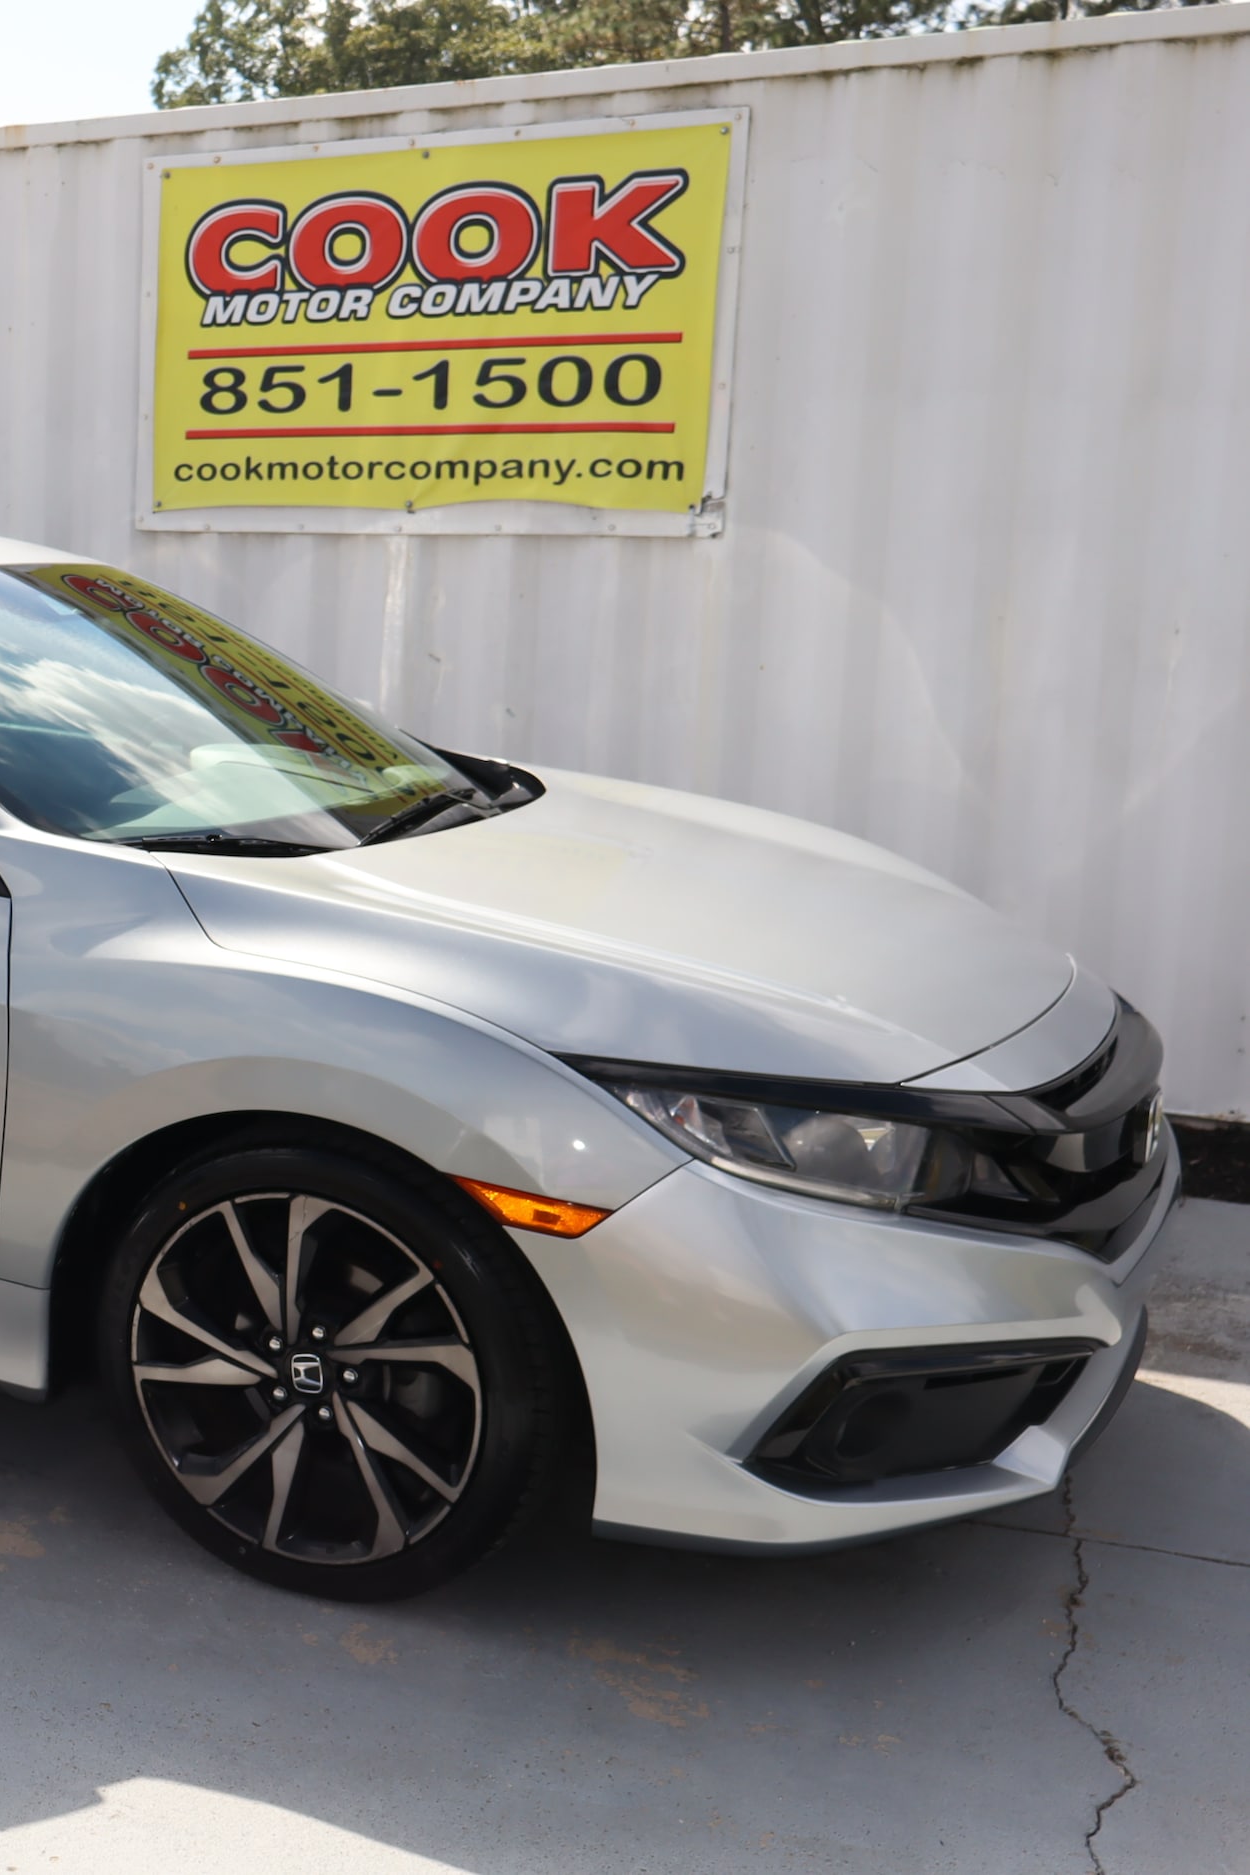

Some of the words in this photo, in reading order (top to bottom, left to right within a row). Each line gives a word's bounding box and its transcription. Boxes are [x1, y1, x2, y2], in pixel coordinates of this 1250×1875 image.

[185, 168, 689, 298] COOK
[201, 287, 373, 327] MOTOR
[386, 273, 659, 319] COMPANY
[199, 354, 663, 415] 851-1500
[173, 455, 685, 486] cookmotorcompany.com
